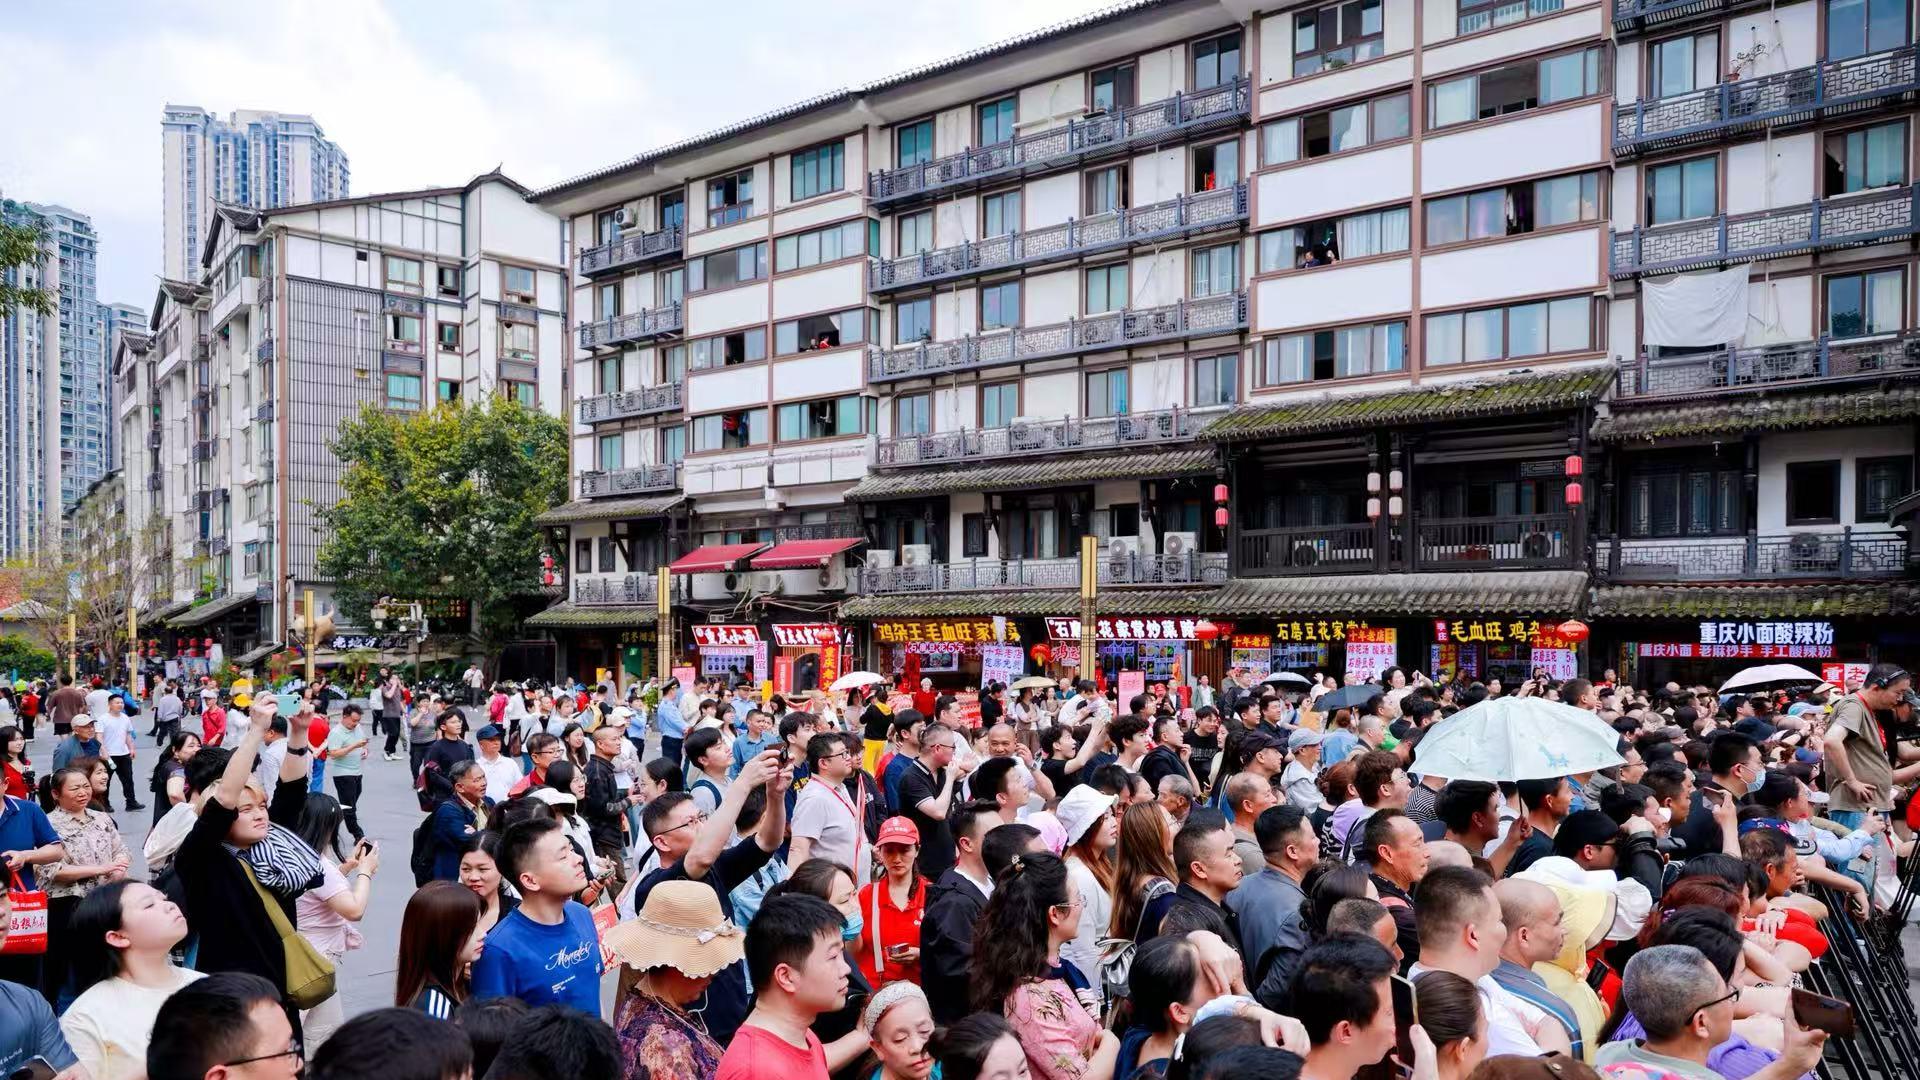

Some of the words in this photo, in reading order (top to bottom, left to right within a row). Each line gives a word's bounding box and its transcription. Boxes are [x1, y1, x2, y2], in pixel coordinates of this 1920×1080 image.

[878, 623, 924, 641] 鸡杂王
[926, 623, 973, 642] 毛血旺
[974, 622, 1021, 642] 家菜
[1277, 620, 1369, 641] 石磨豆花家
[1348, 630, 1385, 642] 十年老店
[1451, 620, 1504, 642] 毛血旺
[1699, 622, 1834, 644] 重庆小面酸辣粉
[333, 635, 377, 649] 老地方
[1232, 635, 1270, 647] 十年老店
[1533, 636, 1568, 648] 十年老
[1640, 644, 1692, 656] 重庆小面
[1698, 644, 1753, 657] 老麻抄手
[1761, 644, 1833, 657] 手工酸辣粉
